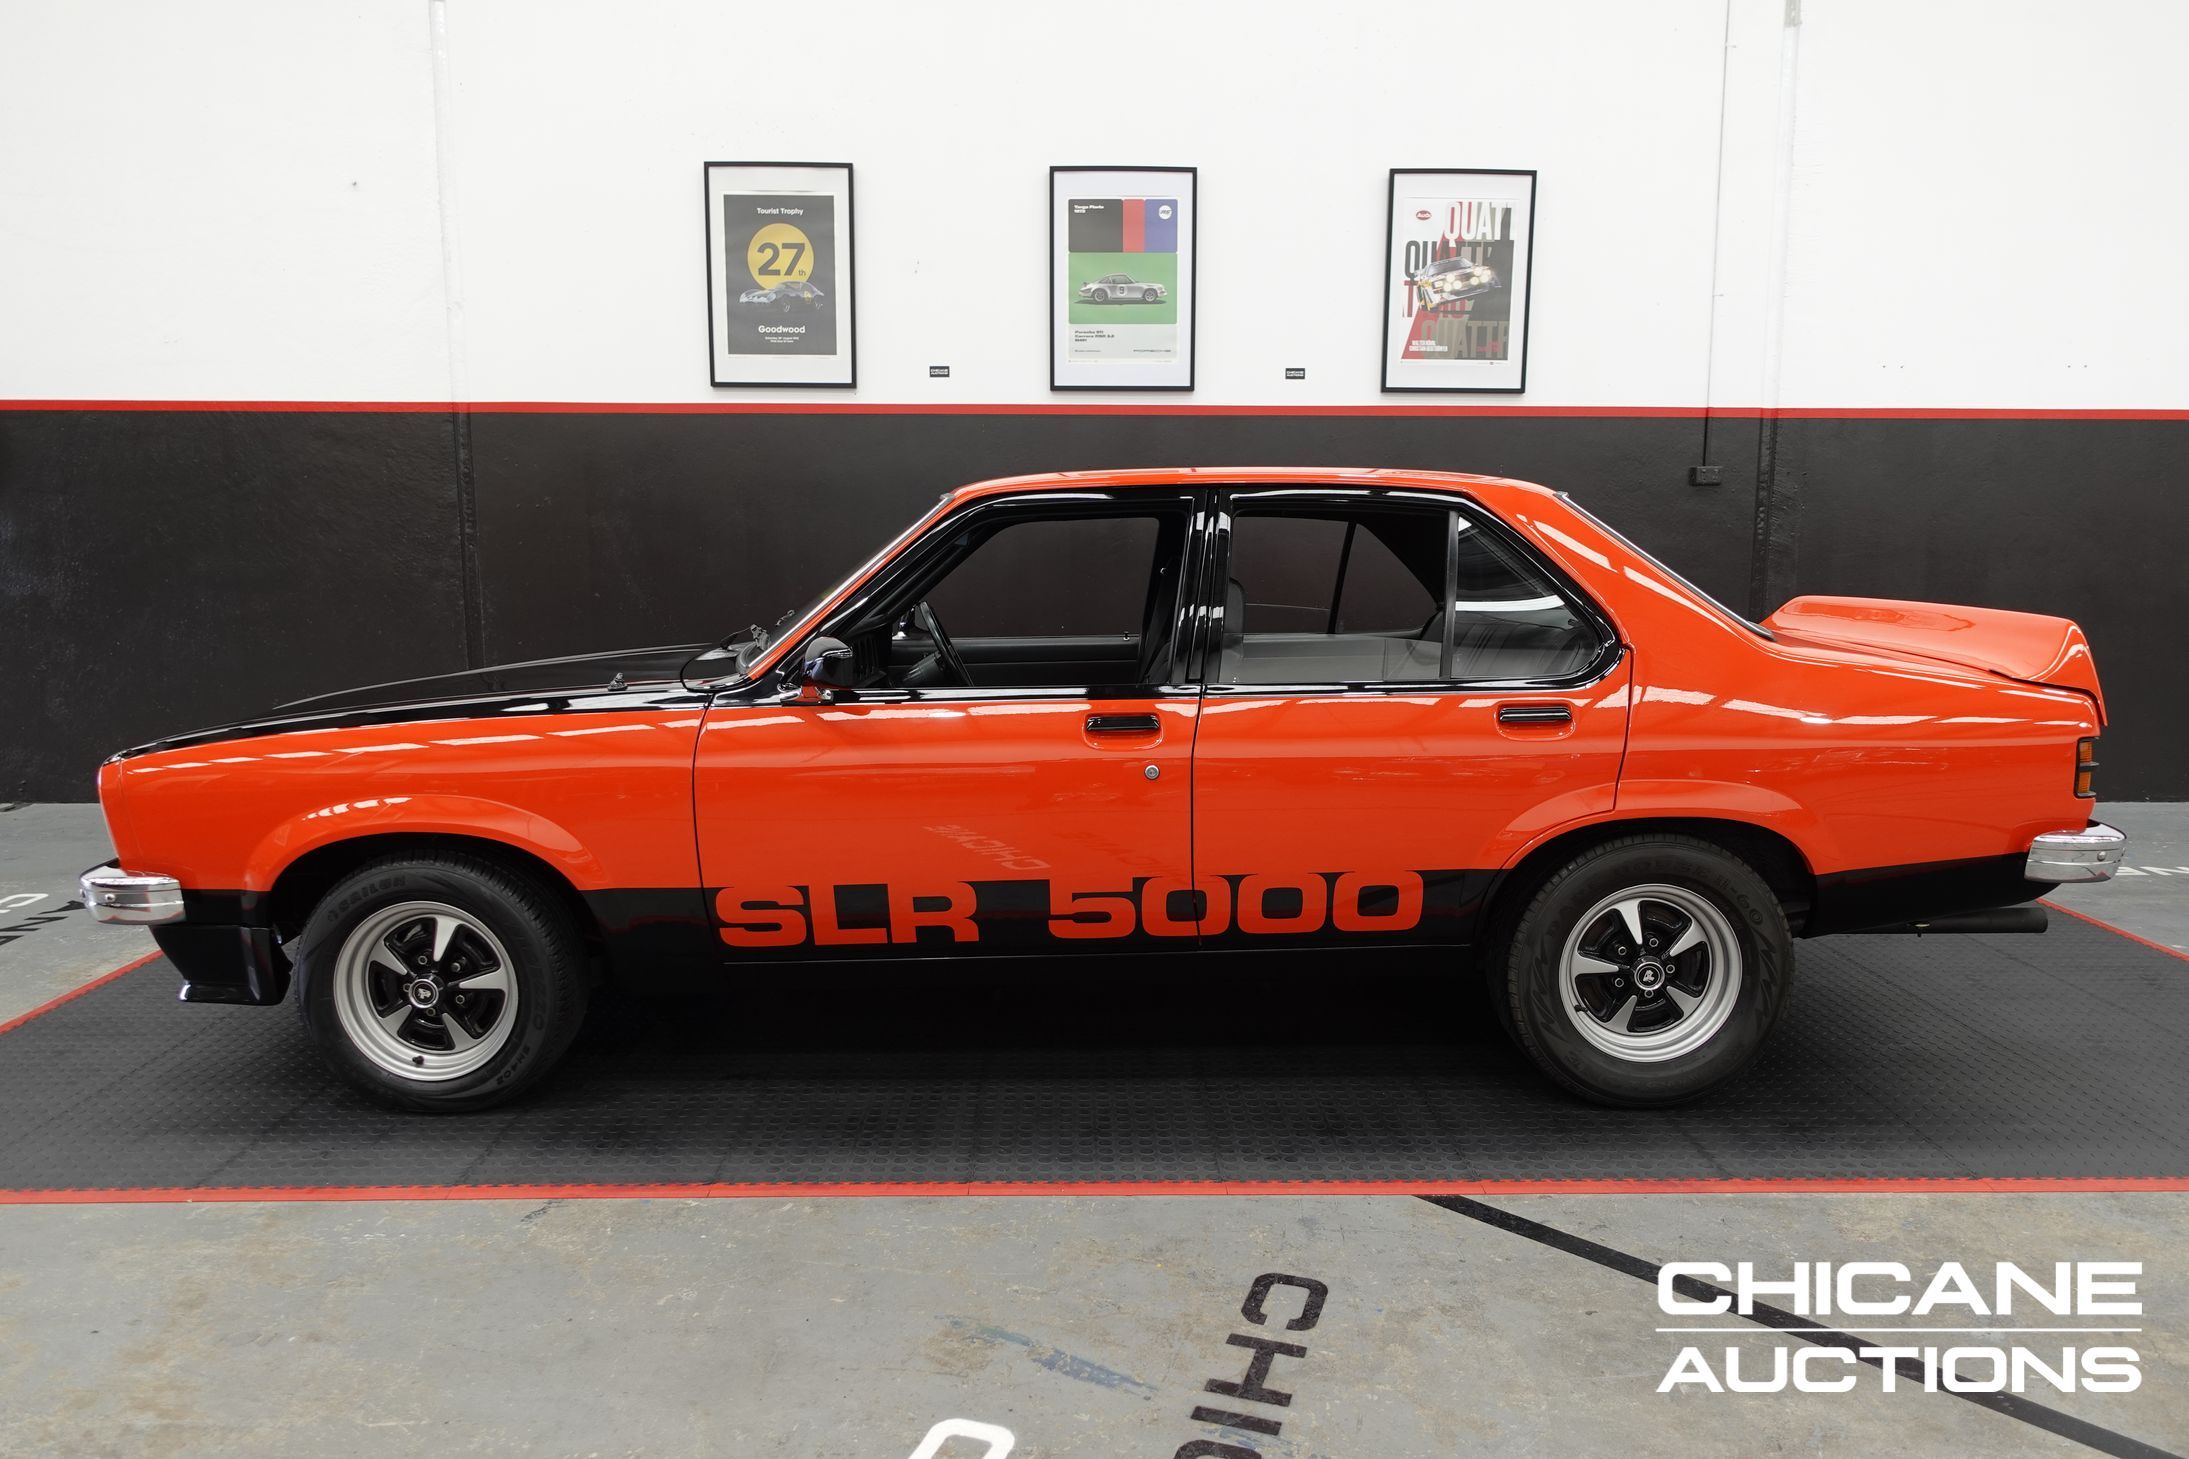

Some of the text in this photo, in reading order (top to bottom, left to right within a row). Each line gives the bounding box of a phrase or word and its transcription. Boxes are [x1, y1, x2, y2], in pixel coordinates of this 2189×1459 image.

[757, 207, 804, 216] Tourist Trophy
[758, 324, 806, 334] Goodwood
[716, 868, 1424, 948] SLR 5000
